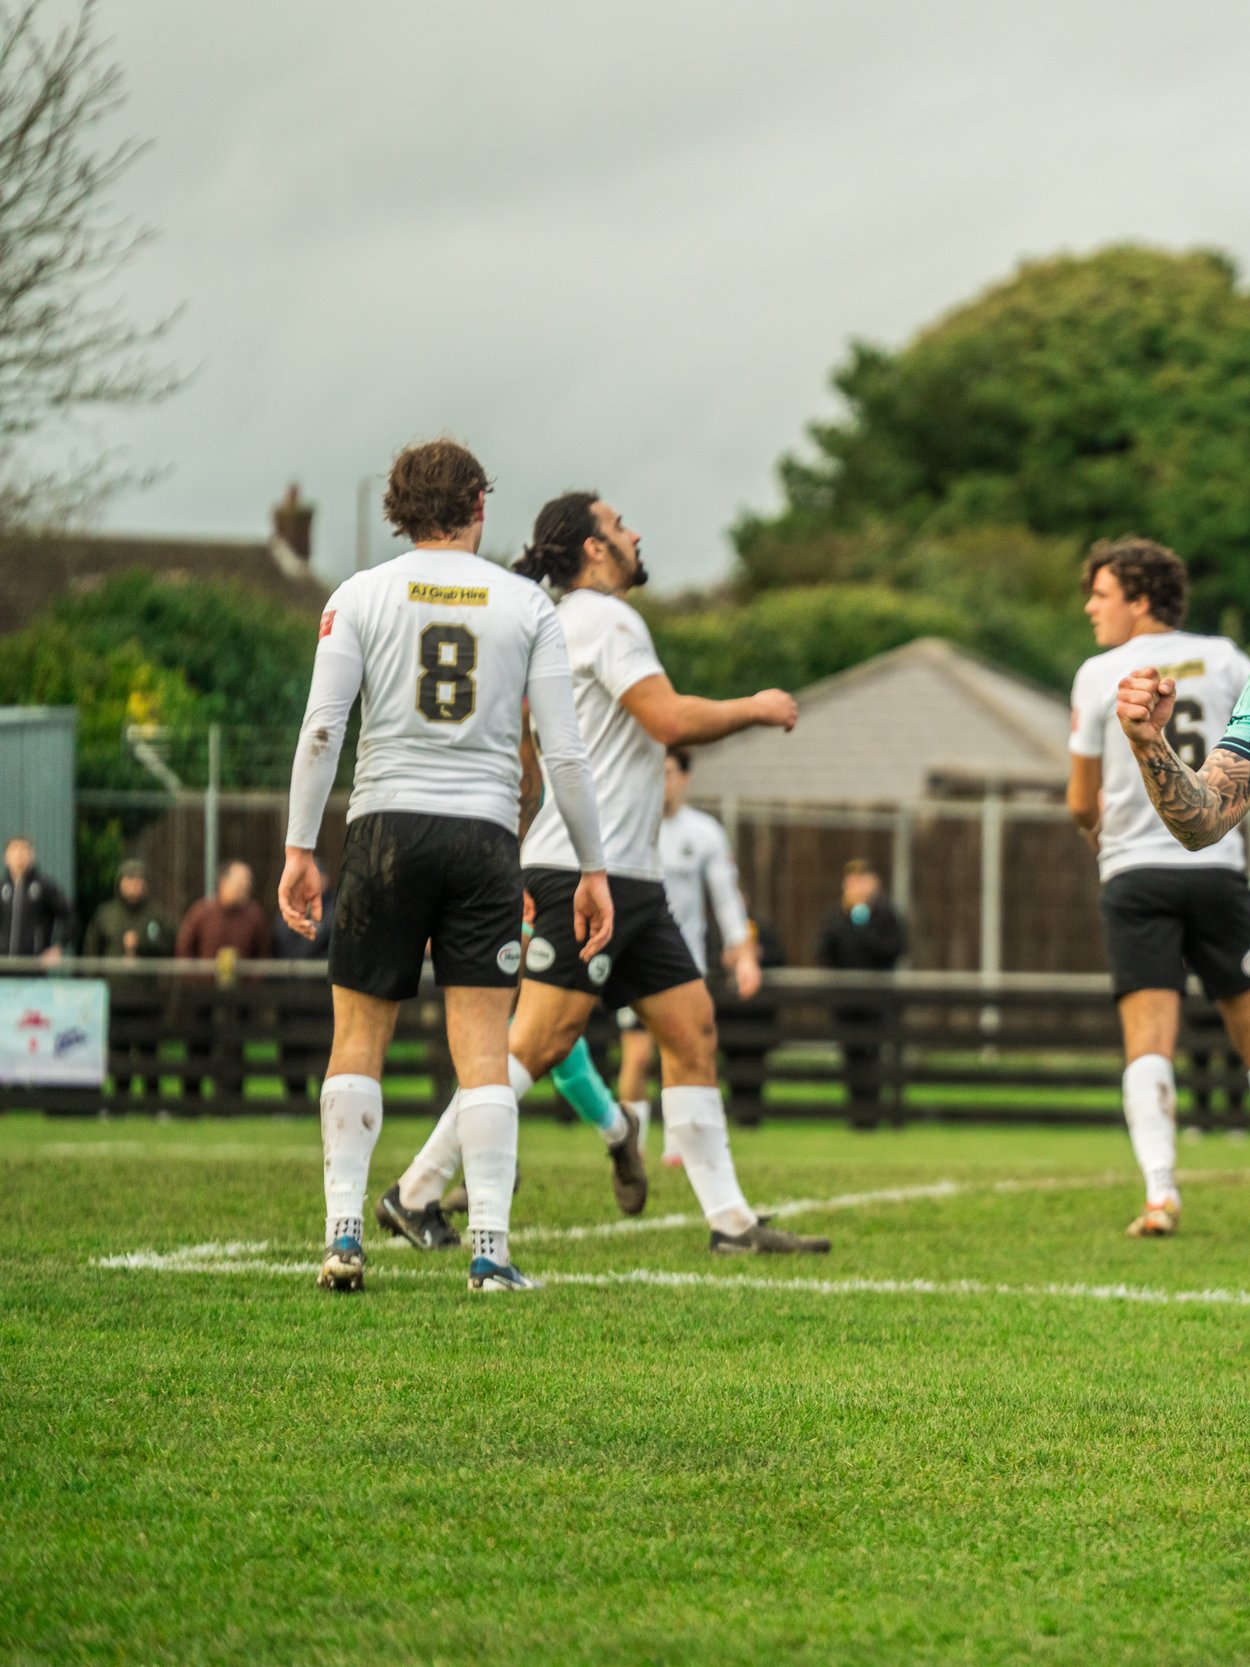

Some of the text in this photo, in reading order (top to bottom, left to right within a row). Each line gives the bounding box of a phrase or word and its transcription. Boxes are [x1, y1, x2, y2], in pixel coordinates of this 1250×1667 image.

[429, 587, 458, 599] Grab
[460, 588, 486, 599] Hire
[416, 621, 478, 724] 8
[1165, 695, 1207, 773] 6
